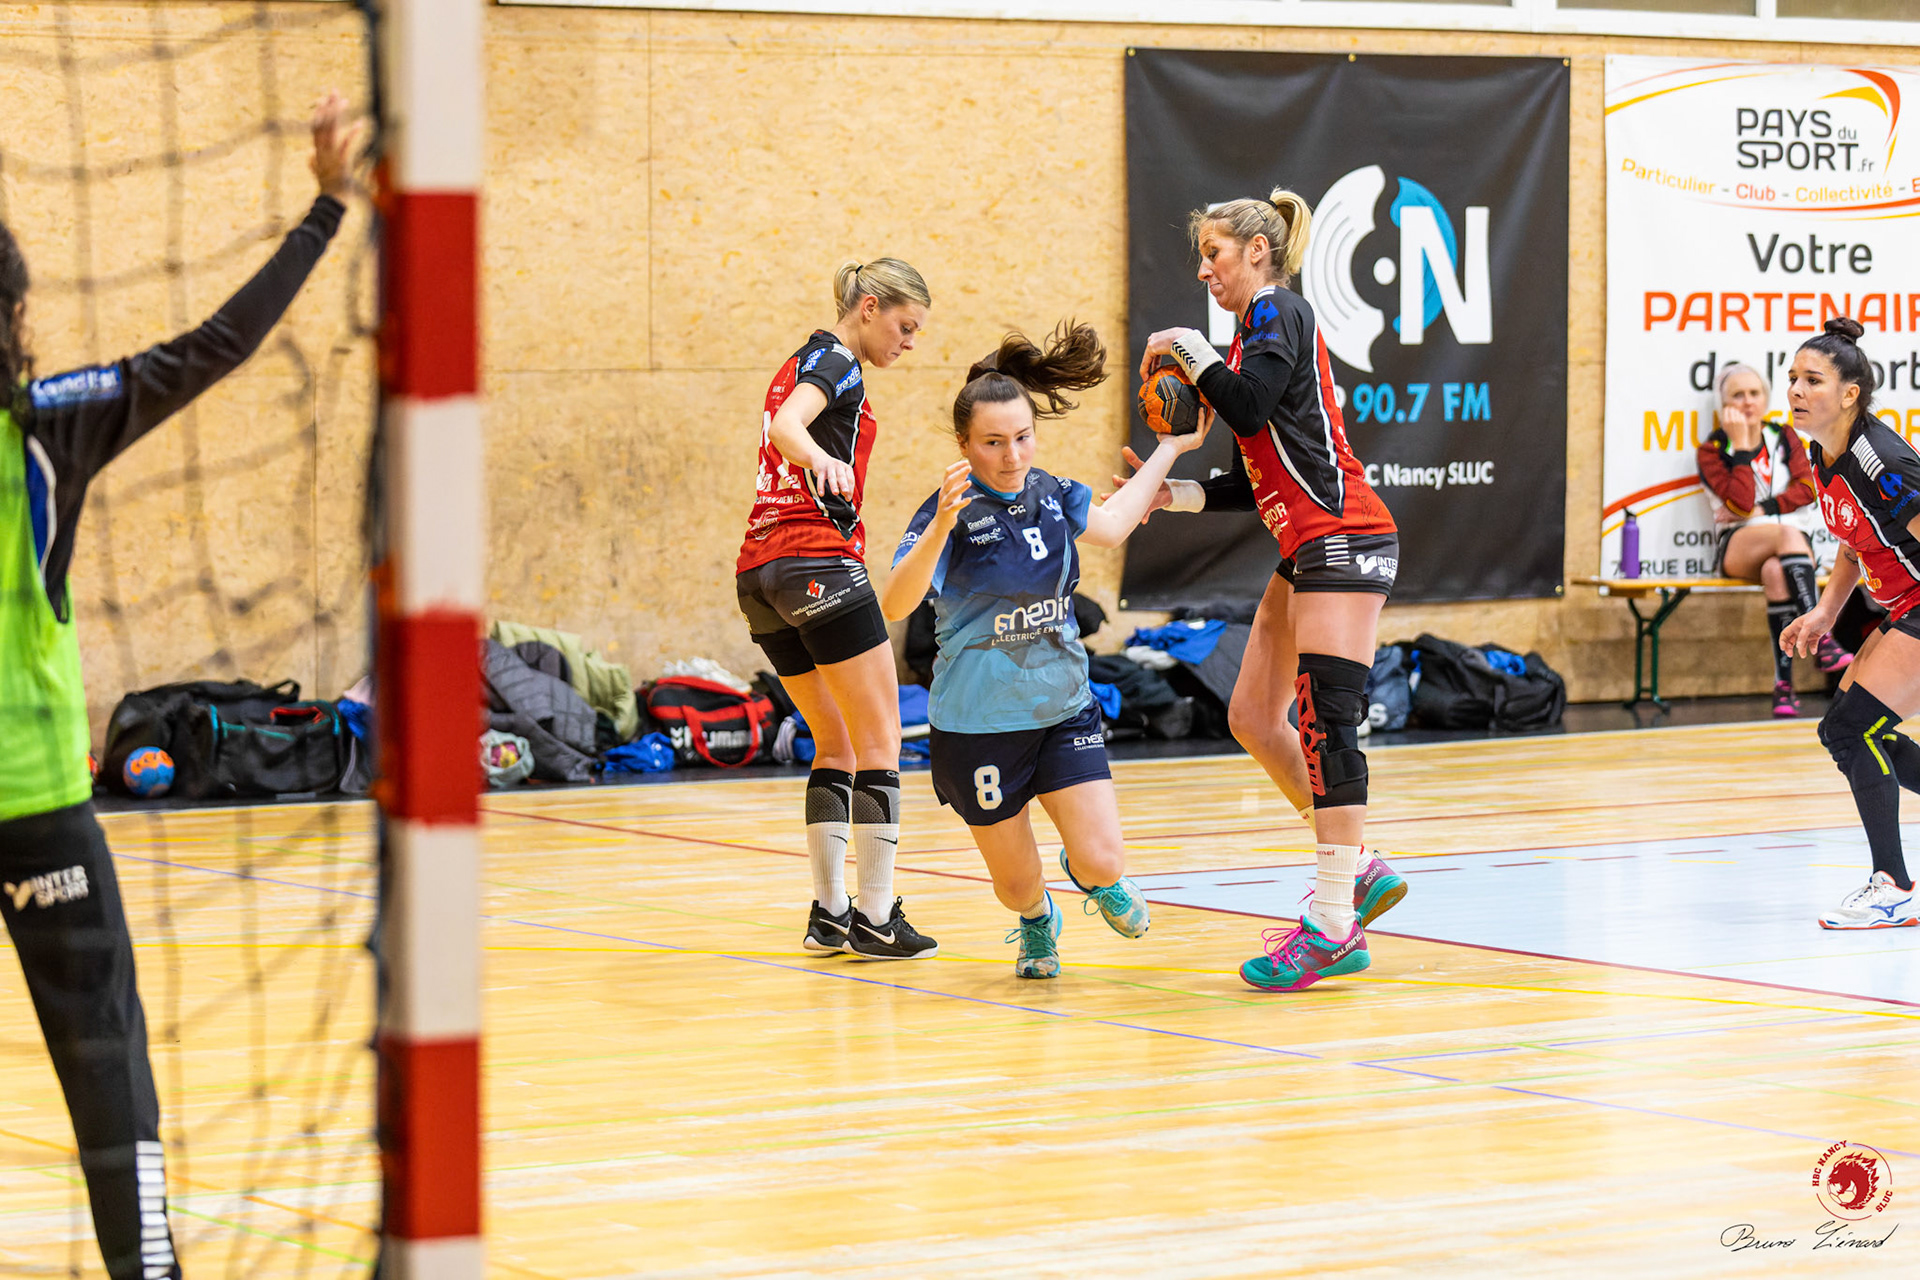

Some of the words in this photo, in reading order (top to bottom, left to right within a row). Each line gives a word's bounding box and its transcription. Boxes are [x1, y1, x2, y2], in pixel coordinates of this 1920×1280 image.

[1736, 108, 1832, 138] PAYS
[1838, 126, 1857, 140] du
[1736, 140, 1859, 171] SPORT
[1621, 158, 1717, 195] Particulier
[1736, 183, 1776, 201] Club
[1795, 179, 1893, 203] Collectivité
[1746, 232, 1873, 274] Votre
[1353, 382, 1431, 423] 90.7
[1443, 382, 1492, 421] FM
[1383, 463, 1447, 491] Nancy
[1447, 460, 1495, 485] SLUC
[1022, 526, 1048, 560] 8
[973, 764, 1003, 810] 8
[1331, 932, 1362, 961] SALMING
